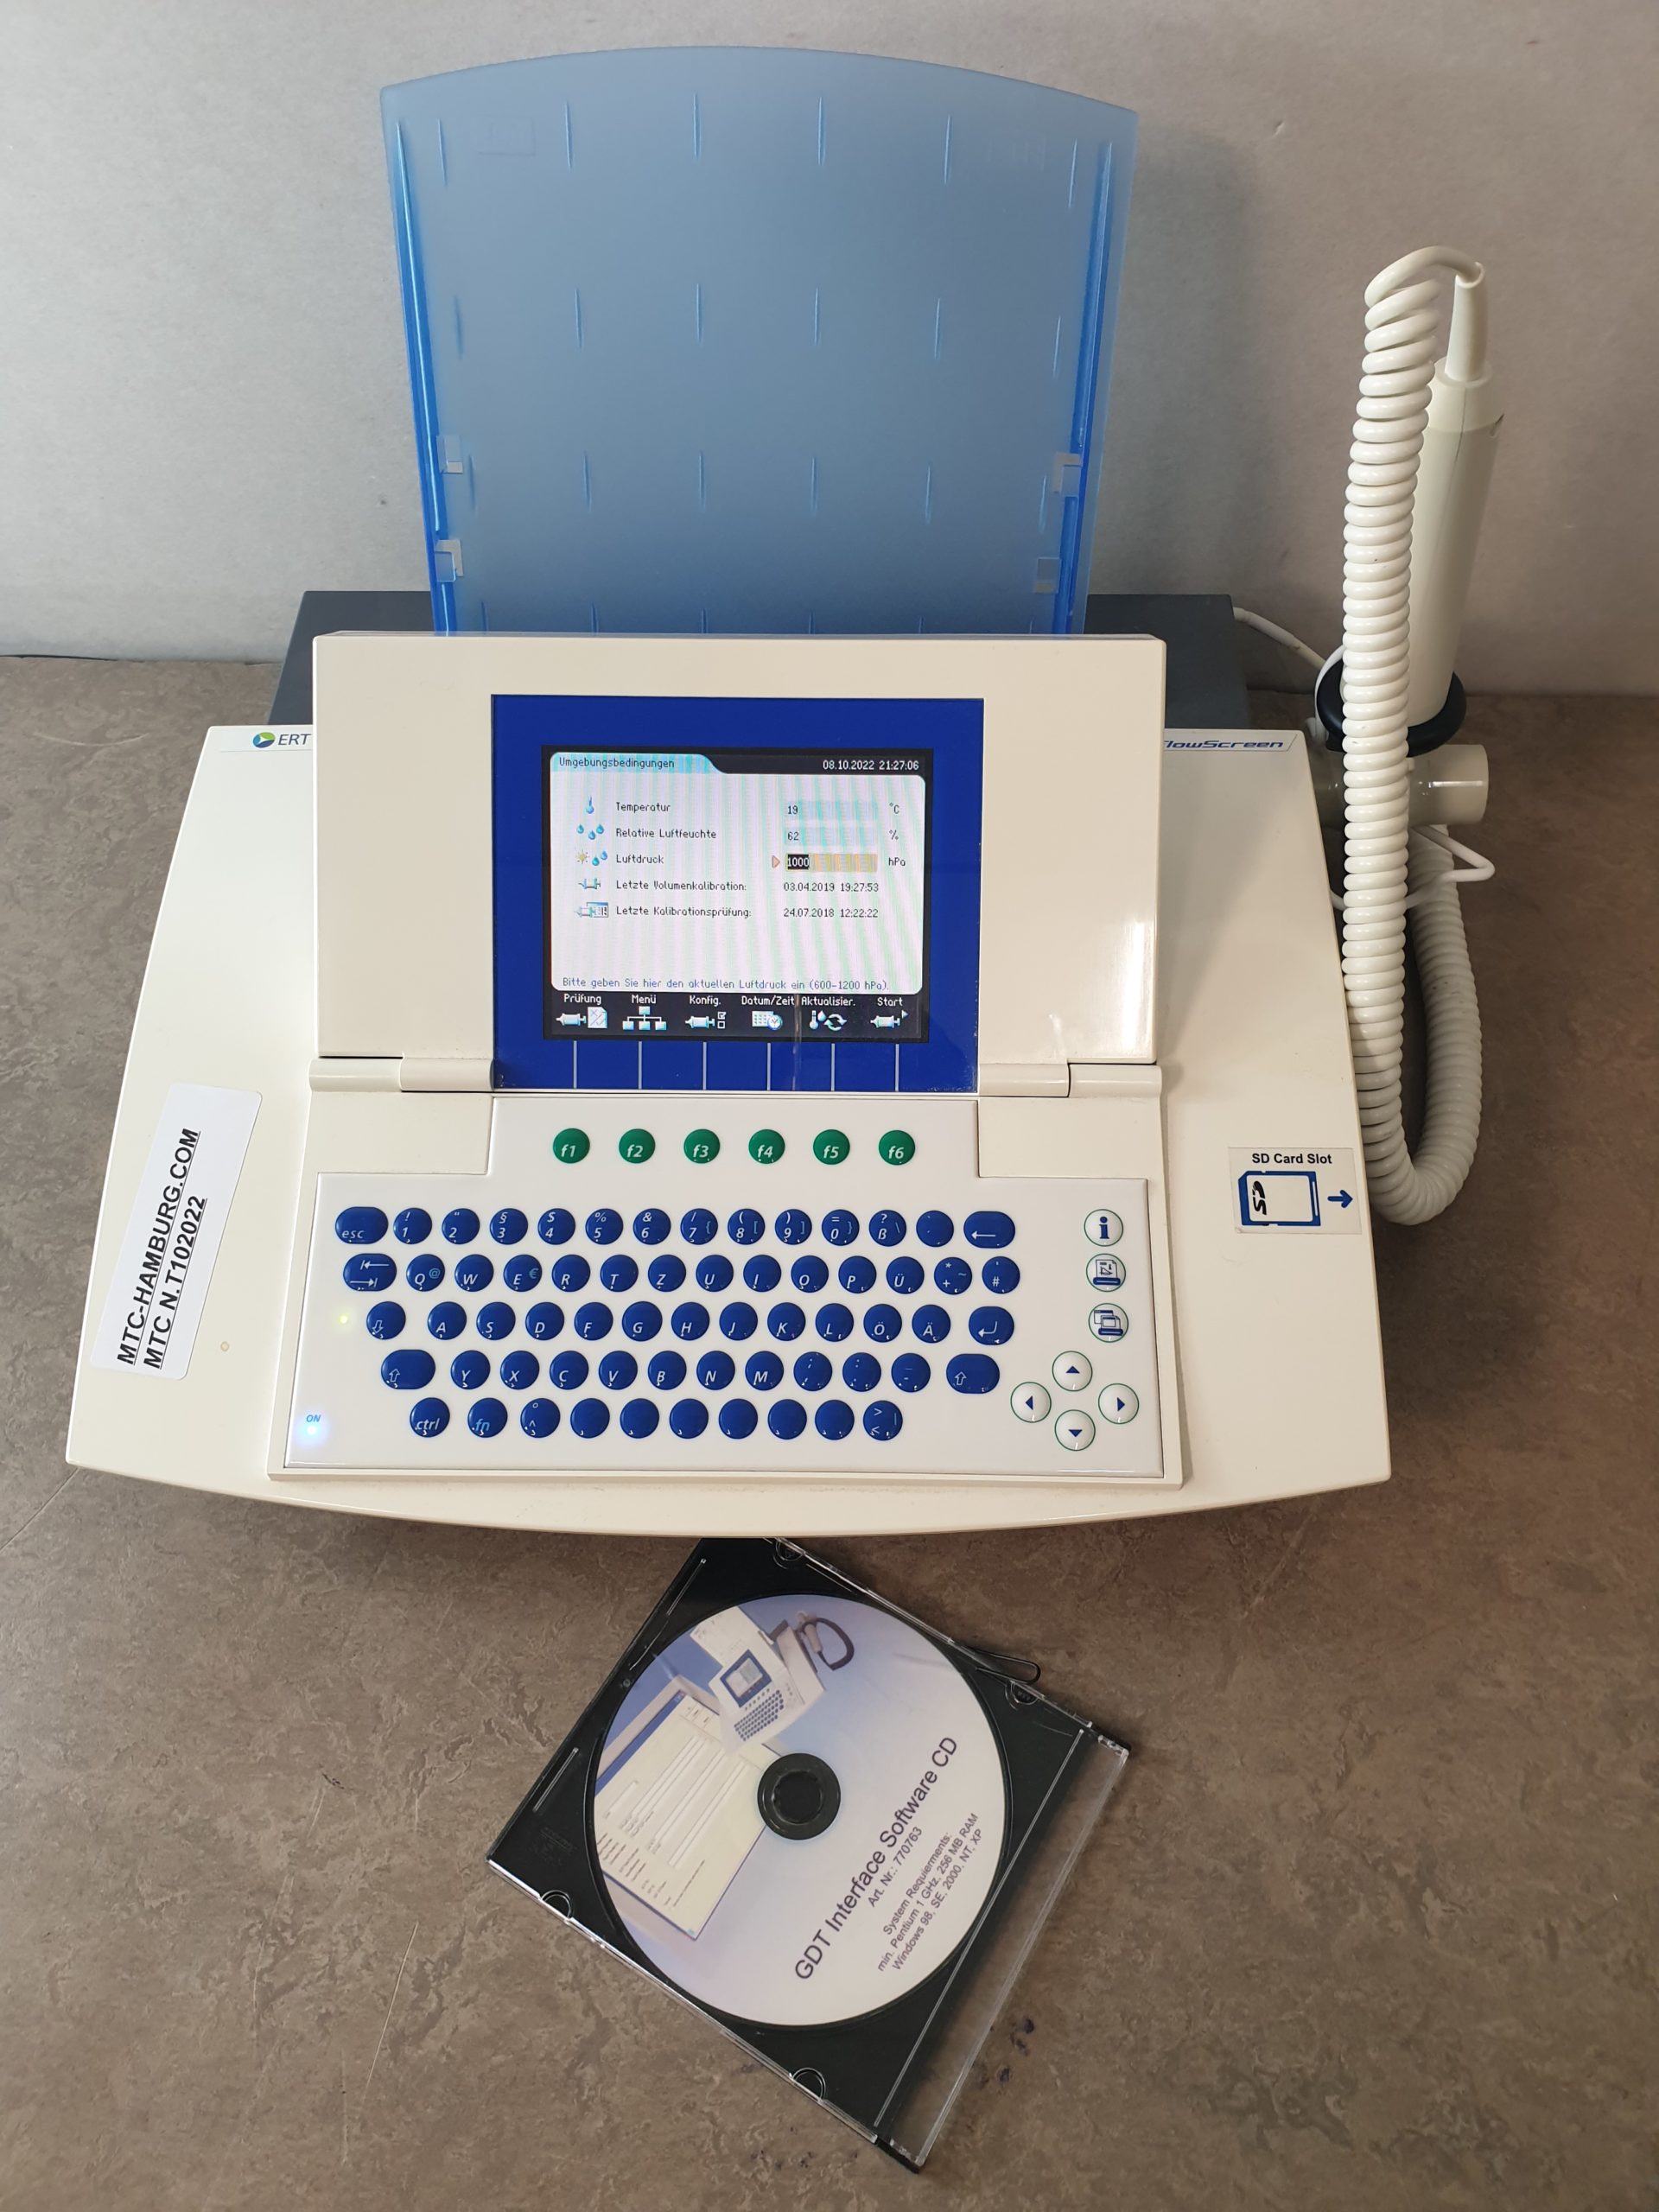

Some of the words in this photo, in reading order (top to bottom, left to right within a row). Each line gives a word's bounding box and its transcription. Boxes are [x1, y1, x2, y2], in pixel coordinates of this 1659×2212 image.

[278, 734, 311, 746] ERT
[559, 757, 675, 769] Umgebungsbedingungen
[823, 760, 874, 771] 08.10.2022
[879, 760, 919, 771] 21:27:06
[615, 802, 671, 814] Temperatur
[787, 805, 798, 815] 19
[615, 828, 655, 838] Relative
[659, 829, 717, 839] Luftfeuchte
[787, 831, 799, 841] 62
[615, 855, 664, 864] Luftdruck
[787, 856, 810, 868] 1000
[888, 856, 906, 867] hPa
[615, 880, 649, 890] Letzte
[653, 880, 747, 892] Volumenkalibration:
[784, 882, 835, 892] 03.04.2019
[840, 882, 879, 892] 19:27:53
[615, 906, 649, 916] Letzte
[653, 906, 752, 918] Kalibrationsprüfung:
[784, 908, 835, 918] 24.07.2018
[840, 908, 879, 918] 12:22:22
[563, 977, 587, 987] Bitte
[591, 978, 620, 988] geben
[625, 978, 639, 988] Sie
[643, 978, 662, 988] hier
[666, 979, 683, 988] den
[689, 979, 734, 988] aktuellen
[739, 980, 786, 989] Luftdruck
[791, 980, 805, 989] ein
[809, 980, 861, 990] (600-1200
[563, 994, 602, 1006] Prüfung
[632, 995, 657, 1004] Menü
[689, 995, 721, 1007] Konfig.
[741, 995, 795, 1006] Datum/Zeit
[801, 996, 856, 1006] Aktualisier.
[877, 996, 903, 1007] Start
[560, 1144, 575, 1159] f1
[626, 1144, 643, 1160] f2
[692, 1144, 709, 1160] f3
[757, 1144, 773, 1160] f4
[823, 1145, 840, 1160] f5
[887, 1145, 905, 1160] f6
[1252, 1153, 1270, 1164] SD
[1274, 1153, 1303, 1164] Card
[1306, 1154, 1332, 1164] Slot
[341, 1230, 365, 1239] esc
[402, 1227, 408, 1238] 1
[448, 1227, 457, 1238] 2
[497, 1227, 505, 1238] 3
[545, 1227, 554, 1238] 4
[594, 1227, 602, 1238] 5
[641, 1227, 649, 1238] 6
[689, 1227, 696, 1238] 7
[735, 1227, 745, 1238] 8
[784, 1227, 791, 1238] 9
[878, 1228, 887, 1240] ß
[117, 1128, 200, 1365] MTC-HAMBURG.COM
[143, 1315, 171, 1370] MTC
[159, 1196, 207, 1311] N.T102022
[414, 1274, 426, 1287] Q
[463, 1274, 478, 1285] W
[513, 1274, 522, 1285] E
[562, 1274, 570, 1285] R
[610, 1274, 619, 1285] T
[657, 1274, 666, 1285] Z
[704, 1274, 715, 1286] U
[847, 1275, 856, 1287] P
[893, 1273, 905, 1287] Ü
[435, 1322, 446, 1333] A
[486, 1322, 494, 1333] S
[534, 1322, 545, 1333] D
[583, 1322, 592, 1333] F
[632, 1322, 643, 1334] G
[681, 1322, 692, 1333] H
[729, 1322, 736, 1334] J
[778, 1322, 788, 1334] K
[825, 1323, 833, 1335] L
[874, 1321, 886, 1336] Ö
[922, 1322, 934, 1336] Ä
[461, 1370, 471, 1382] Y
[508, 1370, 519, 1382] X
[559, 1370, 569, 1382] C
[608, 1370, 619, 1382] V
[657, 1370, 665, 1382] B
[705, 1370, 716, 1382] N
[754, 1370, 768, 1382] M
[306, 1414, 321, 1422] ON
[416, 1418, 441, 1431] ctrl
[474, 1418, 490, 1432] fn
[795, 1929, 831, 1980] GDT
[825, 1851, 886, 1932] Interface
[880, 1770, 938, 1848] Software
[931, 1737, 957, 1767] CD
[868, 1888, 886, 1908] Art.
[893, 1826, 923, 1866] 770763
[878, 1951, 895, 1972] min.
[890, 1909, 919, 1949] Pentium
[937, 1854, 953, 1875] 256
[948, 1837, 963, 1855] MB
[959, 1813, 978, 1838] RAM
[892, 1925, 925, 1971] Windows
[969, 1828, 982, 1846] XP
[883, 1899, 910, 1936] System
